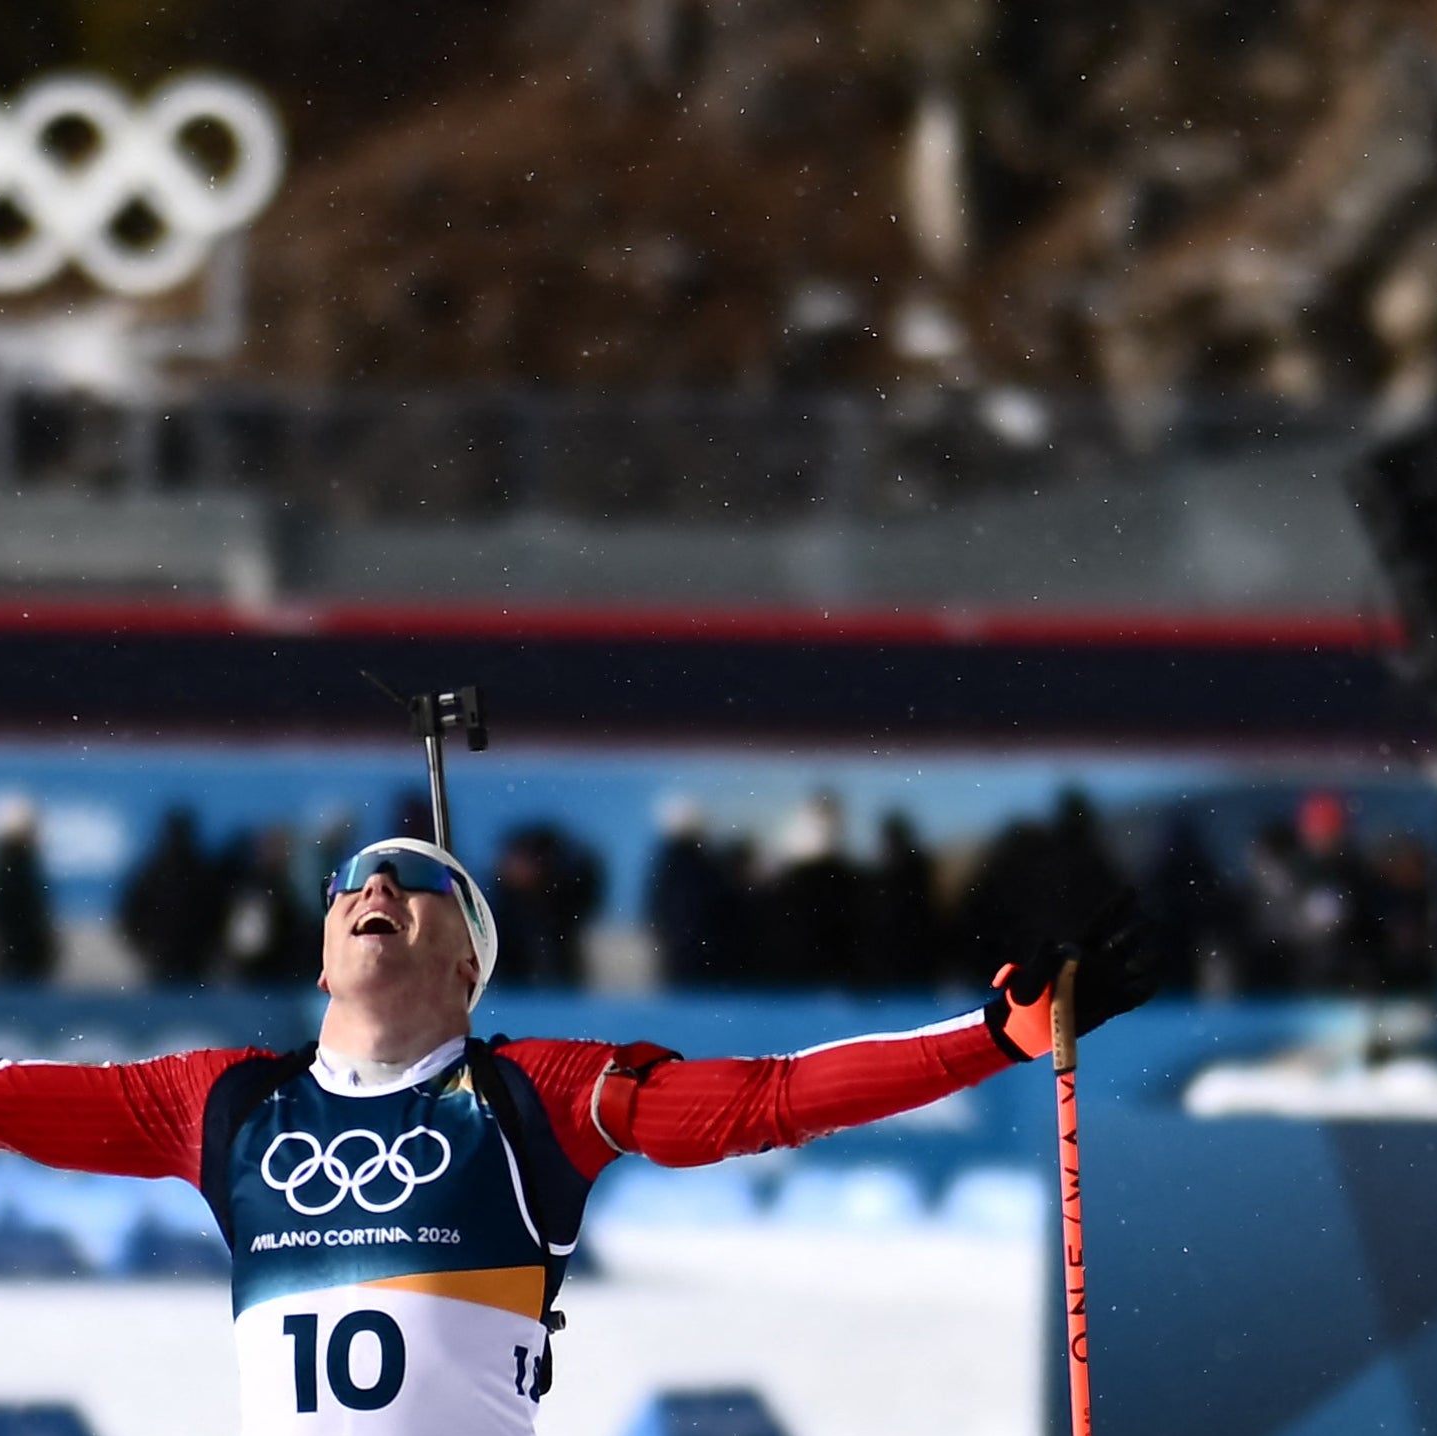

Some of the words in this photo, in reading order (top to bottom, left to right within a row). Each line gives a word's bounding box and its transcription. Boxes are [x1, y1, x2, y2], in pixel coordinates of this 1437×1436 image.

[250, 1230, 321, 1253] MILANO
[323, 1226, 412, 1246] CORTINA
[417, 1227, 461, 1244] 2026
[283, 1309, 406, 1413] 10
